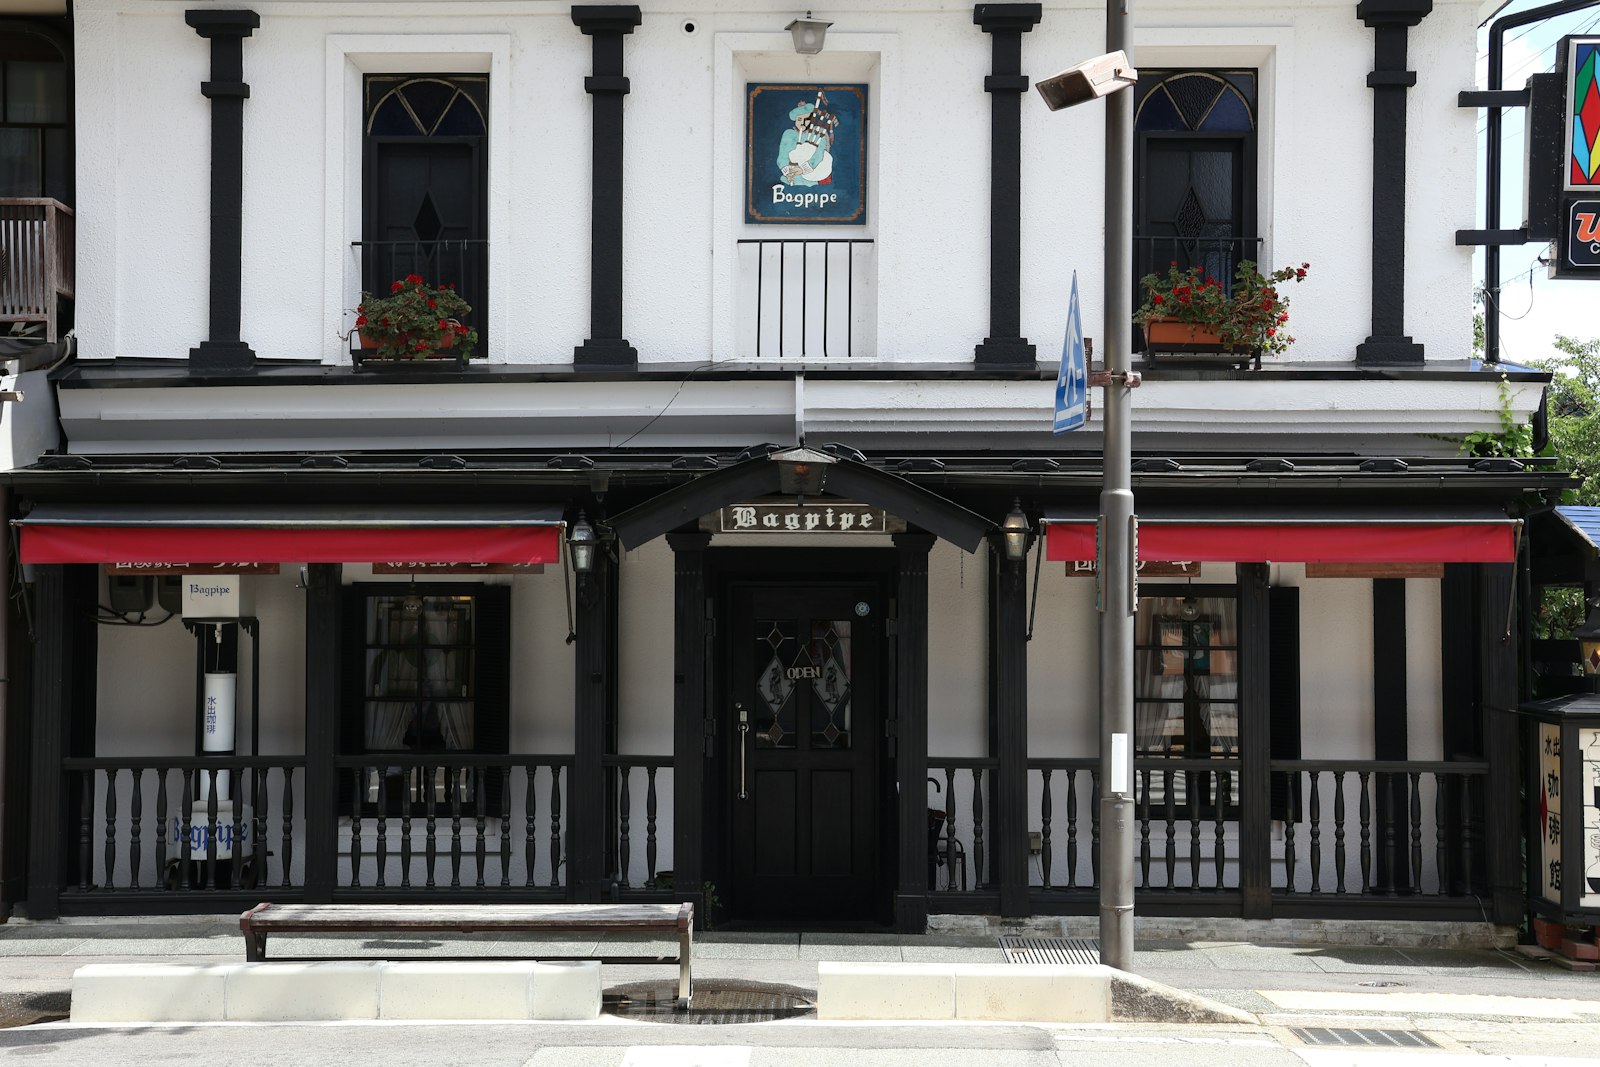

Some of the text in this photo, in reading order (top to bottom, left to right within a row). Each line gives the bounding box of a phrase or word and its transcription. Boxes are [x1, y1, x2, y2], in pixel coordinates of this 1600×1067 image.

[772, 184, 837, 208] Bagpipe
[732, 506, 874, 531] Bagpipe
[189, 584, 230, 600] Bagpipe
[786, 666, 821, 680] OPEN
[174, 816, 249, 852] Bgpipe
